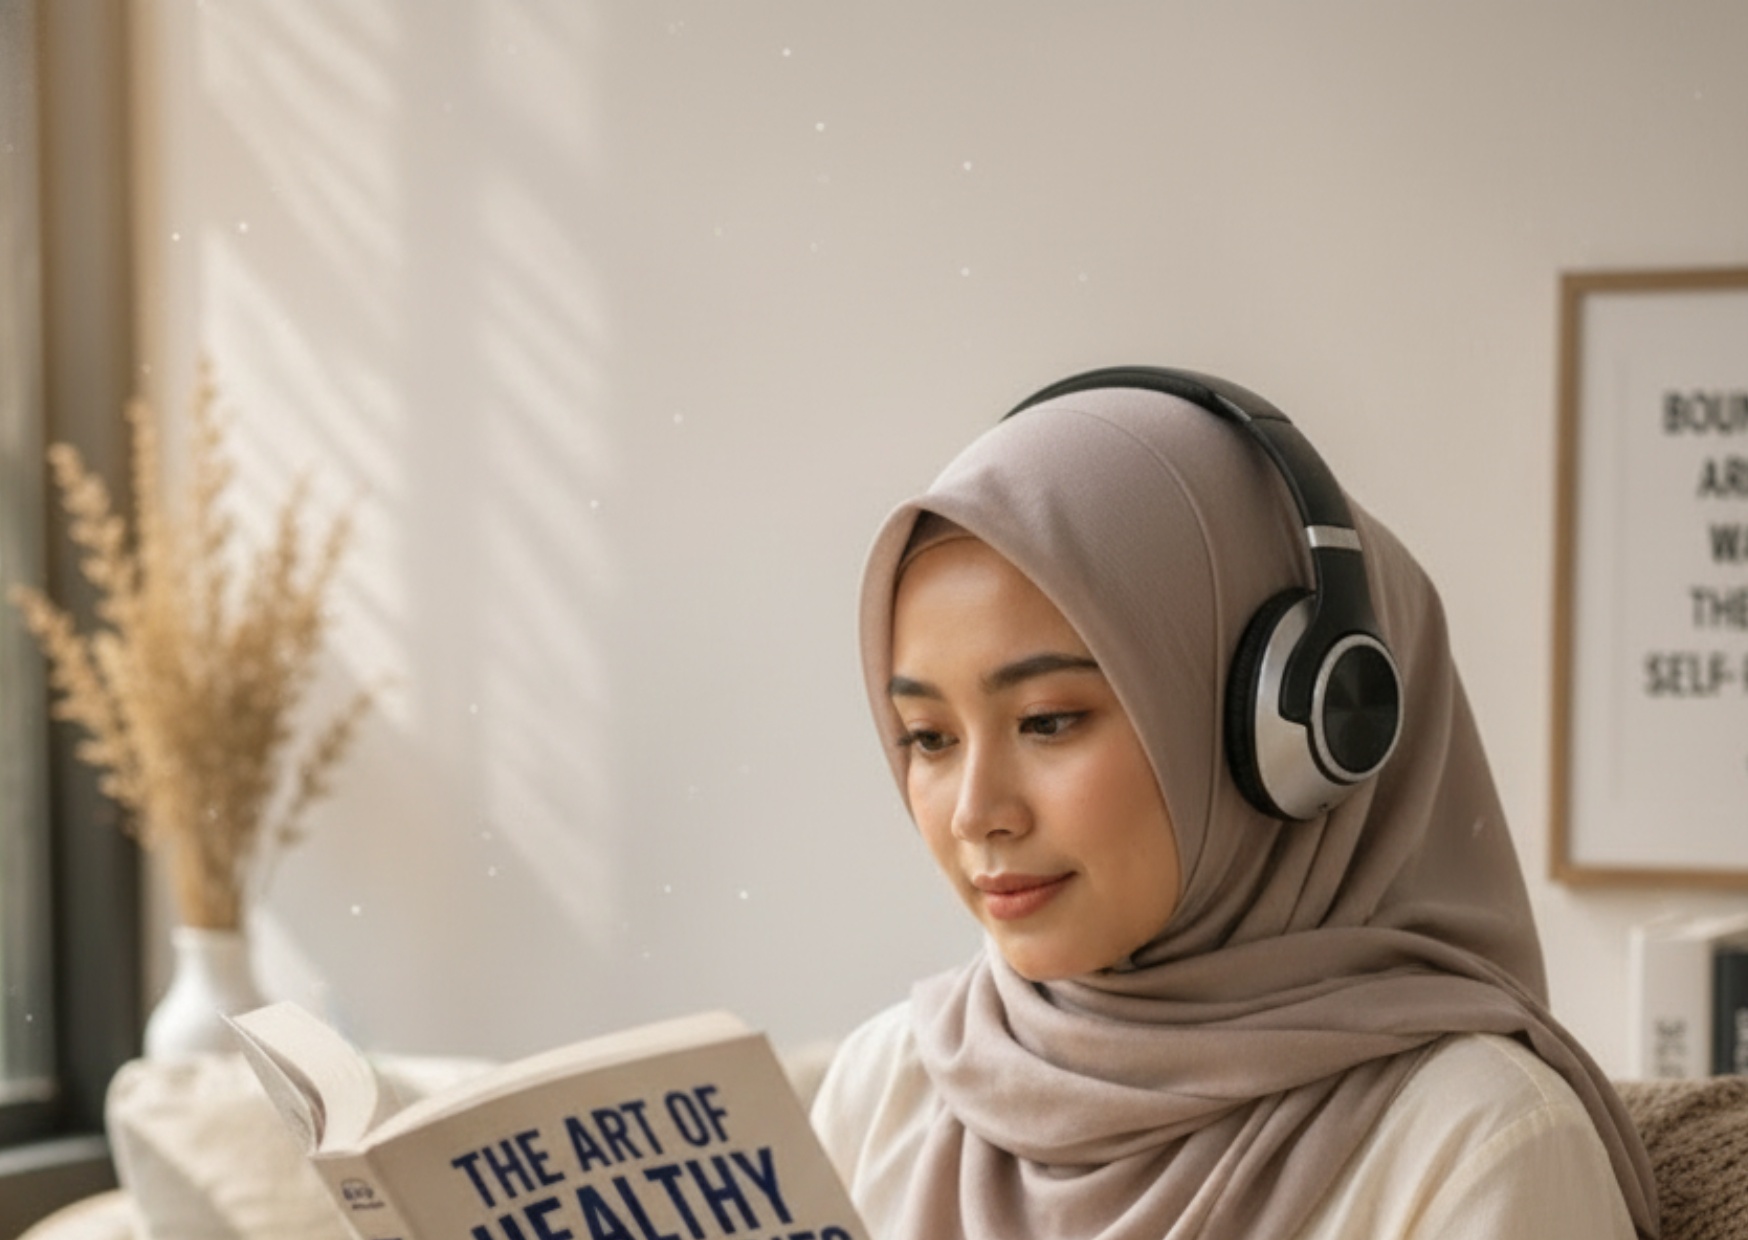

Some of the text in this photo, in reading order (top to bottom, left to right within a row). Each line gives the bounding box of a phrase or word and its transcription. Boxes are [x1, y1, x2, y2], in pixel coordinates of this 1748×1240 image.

[1709, 523, 1748, 565] W
[1644, 651, 1748, 698] SELF-
[451, 1130, 565, 1208] THE
[564, 1100, 664, 1172] ART
[664, 1085, 729, 1148] OF
